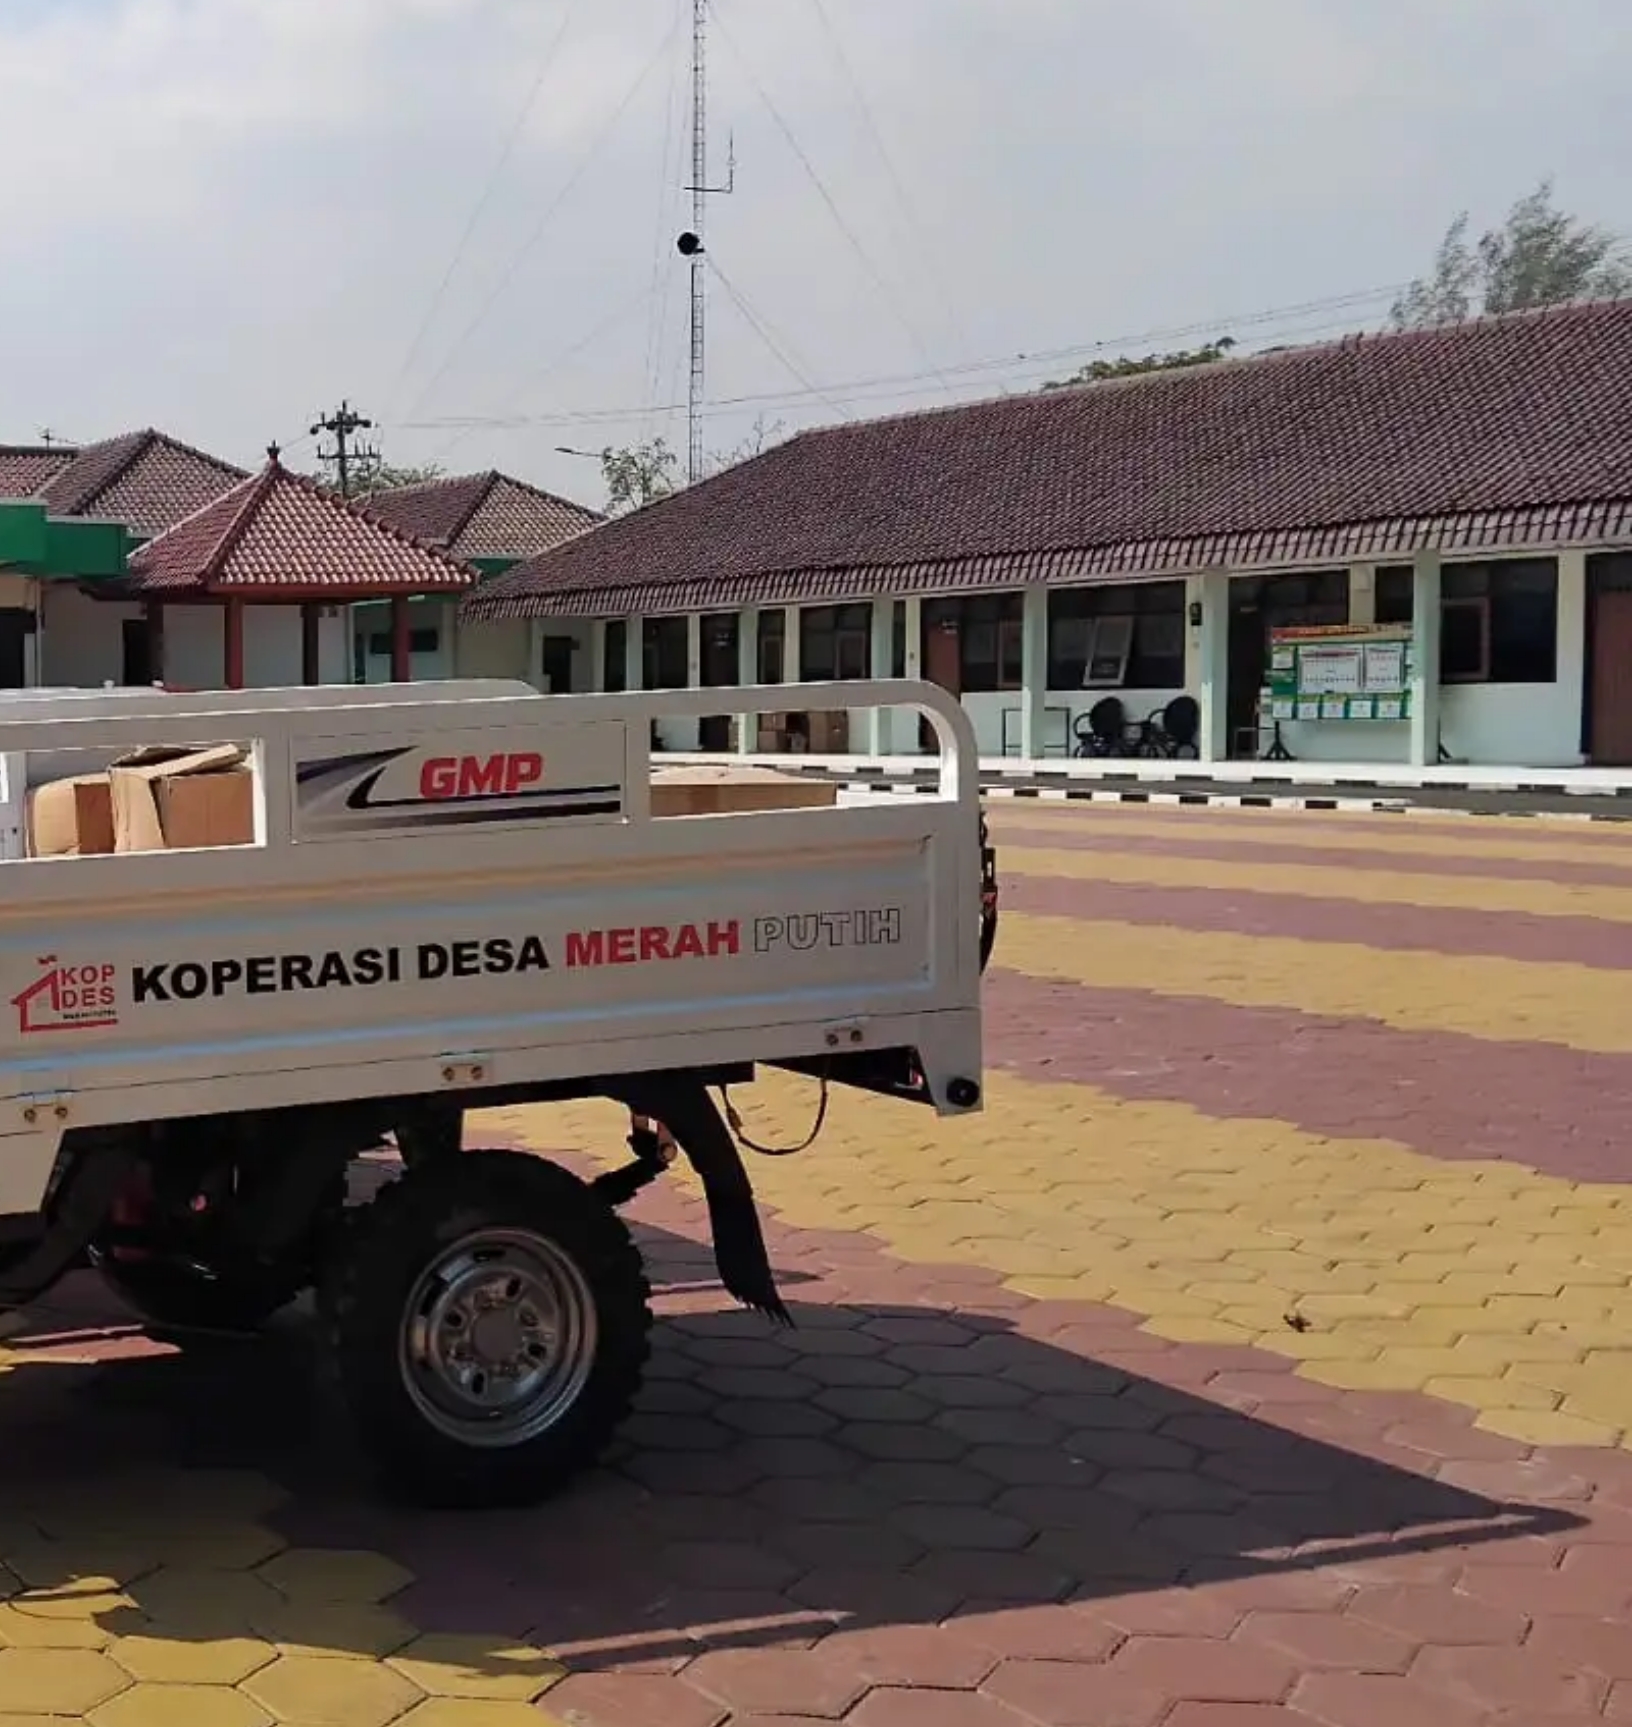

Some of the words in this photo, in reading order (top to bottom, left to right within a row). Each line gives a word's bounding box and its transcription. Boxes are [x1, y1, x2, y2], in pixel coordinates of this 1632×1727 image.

[419, 753, 543, 799] GMP
[132, 947, 400, 1002] KOPERASI
[417, 936, 550, 979] DESA
[565, 919, 739, 967] MERAH
[754, 908, 900, 952] PUTIH
[60, 965, 115, 986] KOP
[62, 986, 115, 1009] DES
